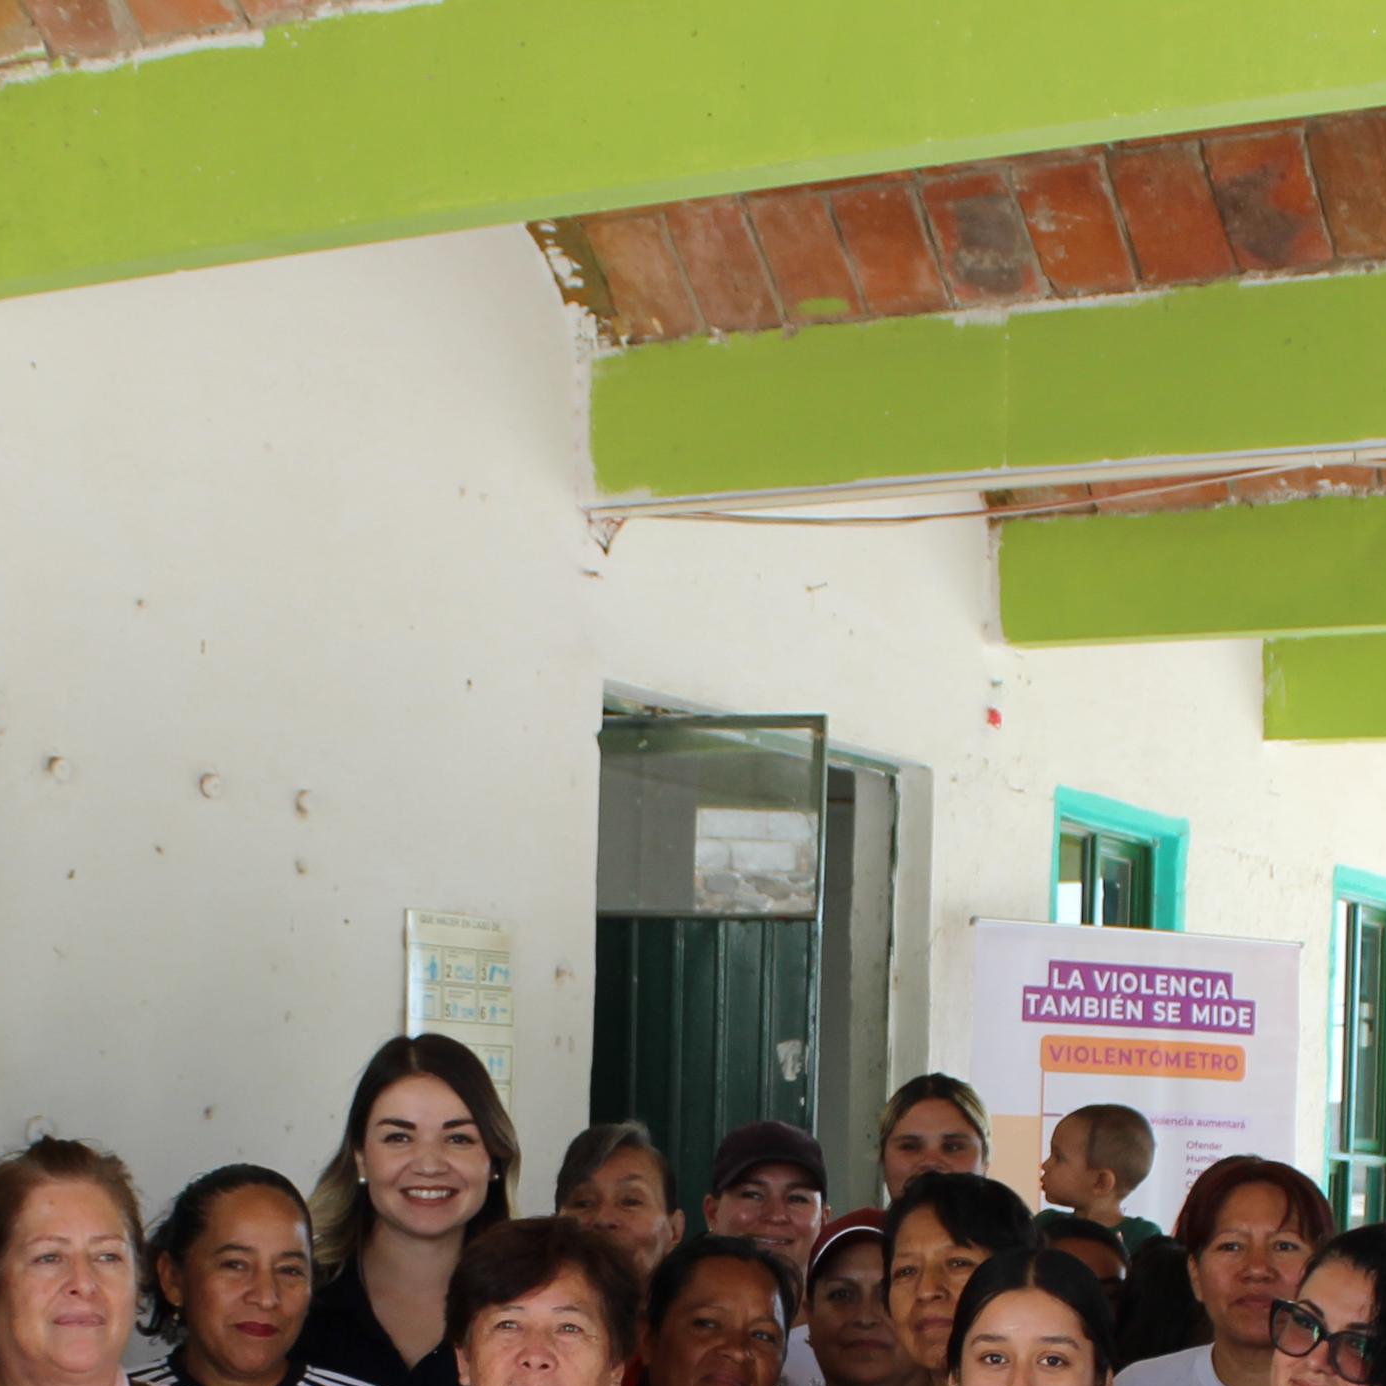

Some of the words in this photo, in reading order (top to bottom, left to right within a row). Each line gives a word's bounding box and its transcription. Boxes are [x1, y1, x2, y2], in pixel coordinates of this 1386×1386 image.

[1052, 968, 1085, 991] LA
[1094, 971, 1229, 1000] VIOLENCIA
[1025, 993, 1143, 1021] TAMBIÉN
[1153, 1001, 1182, 1023] SE
[1192, 1003, 1252, 1029] MIDE
[1048, 1044, 1238, 1073] VIOLENTÓMETRO
